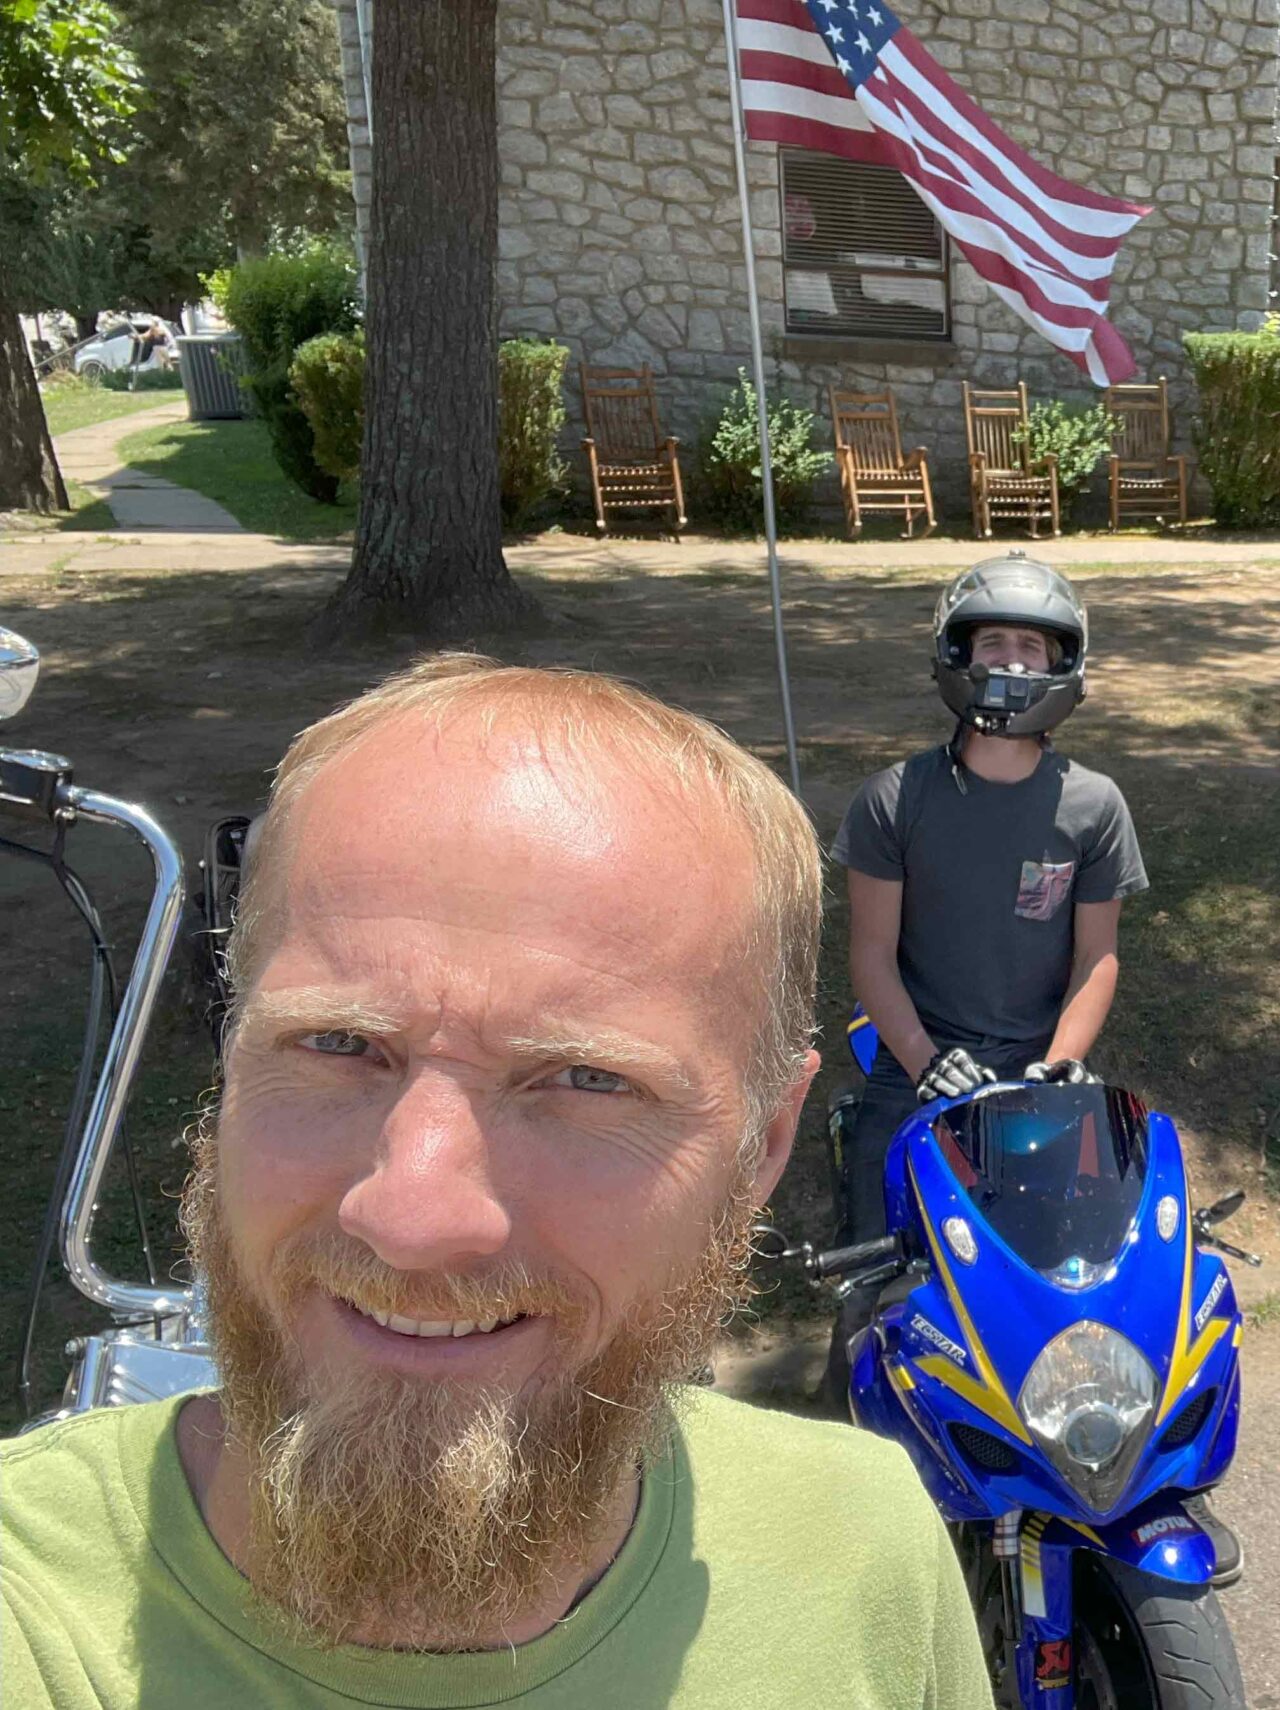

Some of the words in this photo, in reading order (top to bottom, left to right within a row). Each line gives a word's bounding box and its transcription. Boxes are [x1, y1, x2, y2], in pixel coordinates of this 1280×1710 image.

[1195, 1274, 1227, 1330] ECSTAR
[911, 1315, 966, 1366] ECSTAR
[1137, 1516, 1193, 1542] MOTUL
